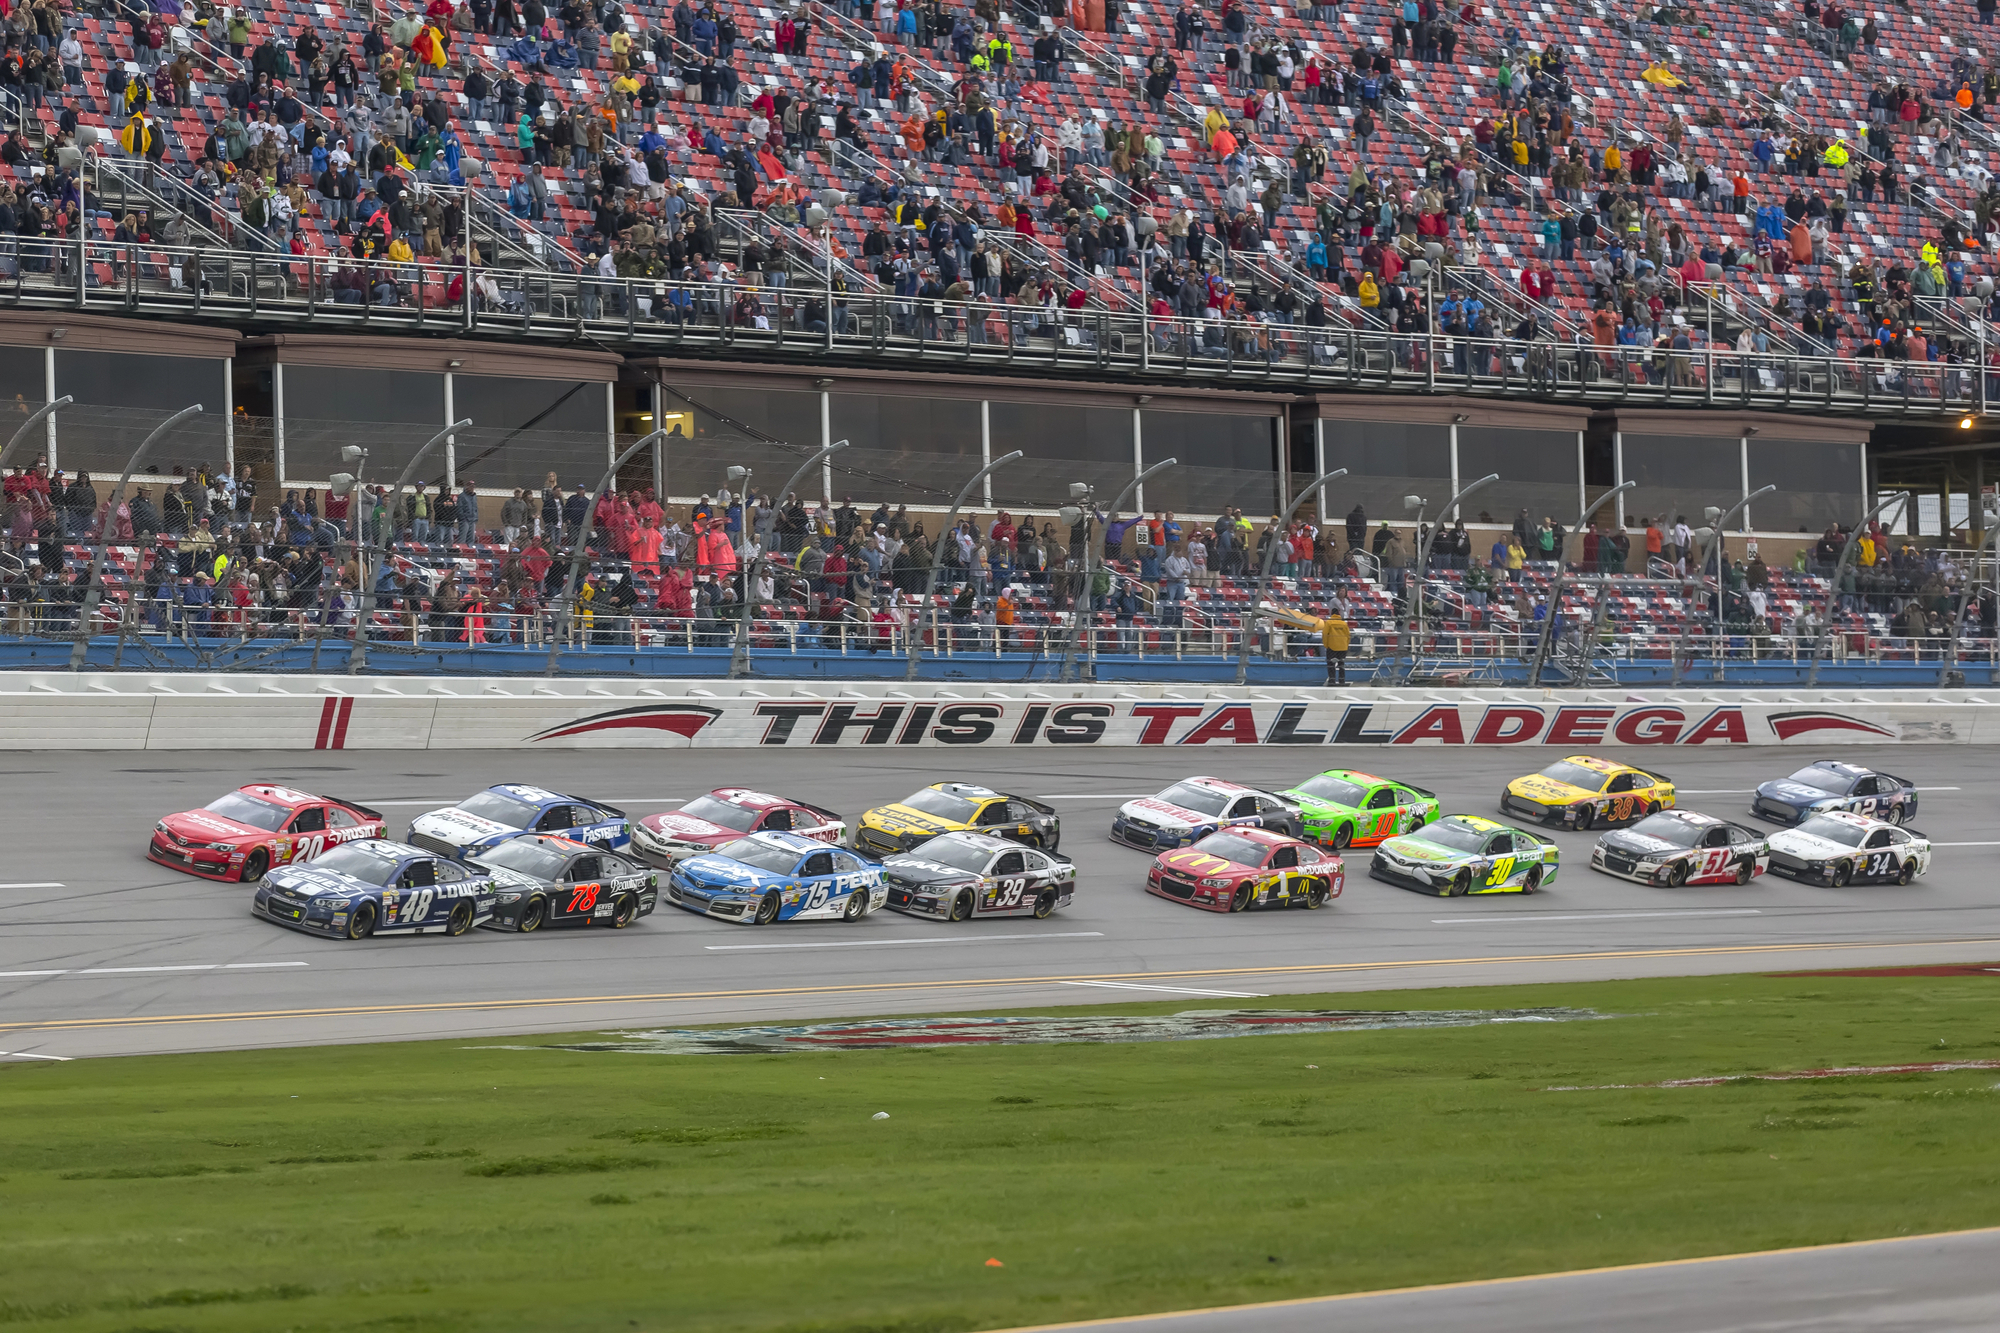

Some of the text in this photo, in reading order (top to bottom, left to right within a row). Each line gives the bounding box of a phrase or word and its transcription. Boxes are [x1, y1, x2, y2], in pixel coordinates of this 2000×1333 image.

[1137, 533, 1147, 543] BB
[753, 702, 1748, 745] THIS IS TALLADEGA
[876, 807, 938, 830] STANLEY
[1607, 797, 1634, 822] 38
[342, 825, 377, 842] HUSKY
[1371, 812, 1396, 838] 10
[165, 843, 195, 856] CAMRY
[291, 834, 325, 865] 20
[645, 843, 672, 855] CAMRY
[681, 857, 767, 888] PEAK
[690, 865, 722, 876] MOTOR
[882, 859, 958, 875] HAAS
[1295, 862, 1338, 876] McDonald's
[1485, 857, 1516, 886] 30
[1702, 850, 1730, 875] 51
[1773, 866, 1797, 877] FUSION
[1867, 853, 1891, 876] 34
[281, 867, 350, 893] LOWE'S
[434, 879, 490, 900] LOWE'S
[683, 886, 712, 898] CAMRY
[834, 869, 883, 895] PEAK
[995, 878, 1026, 907] 39
[1277, 871, 1290, 897] 1
[400, 889, 434, 923] 48
[566, 882, 601, 913] 78
[802, 880, 832, 911] 15
